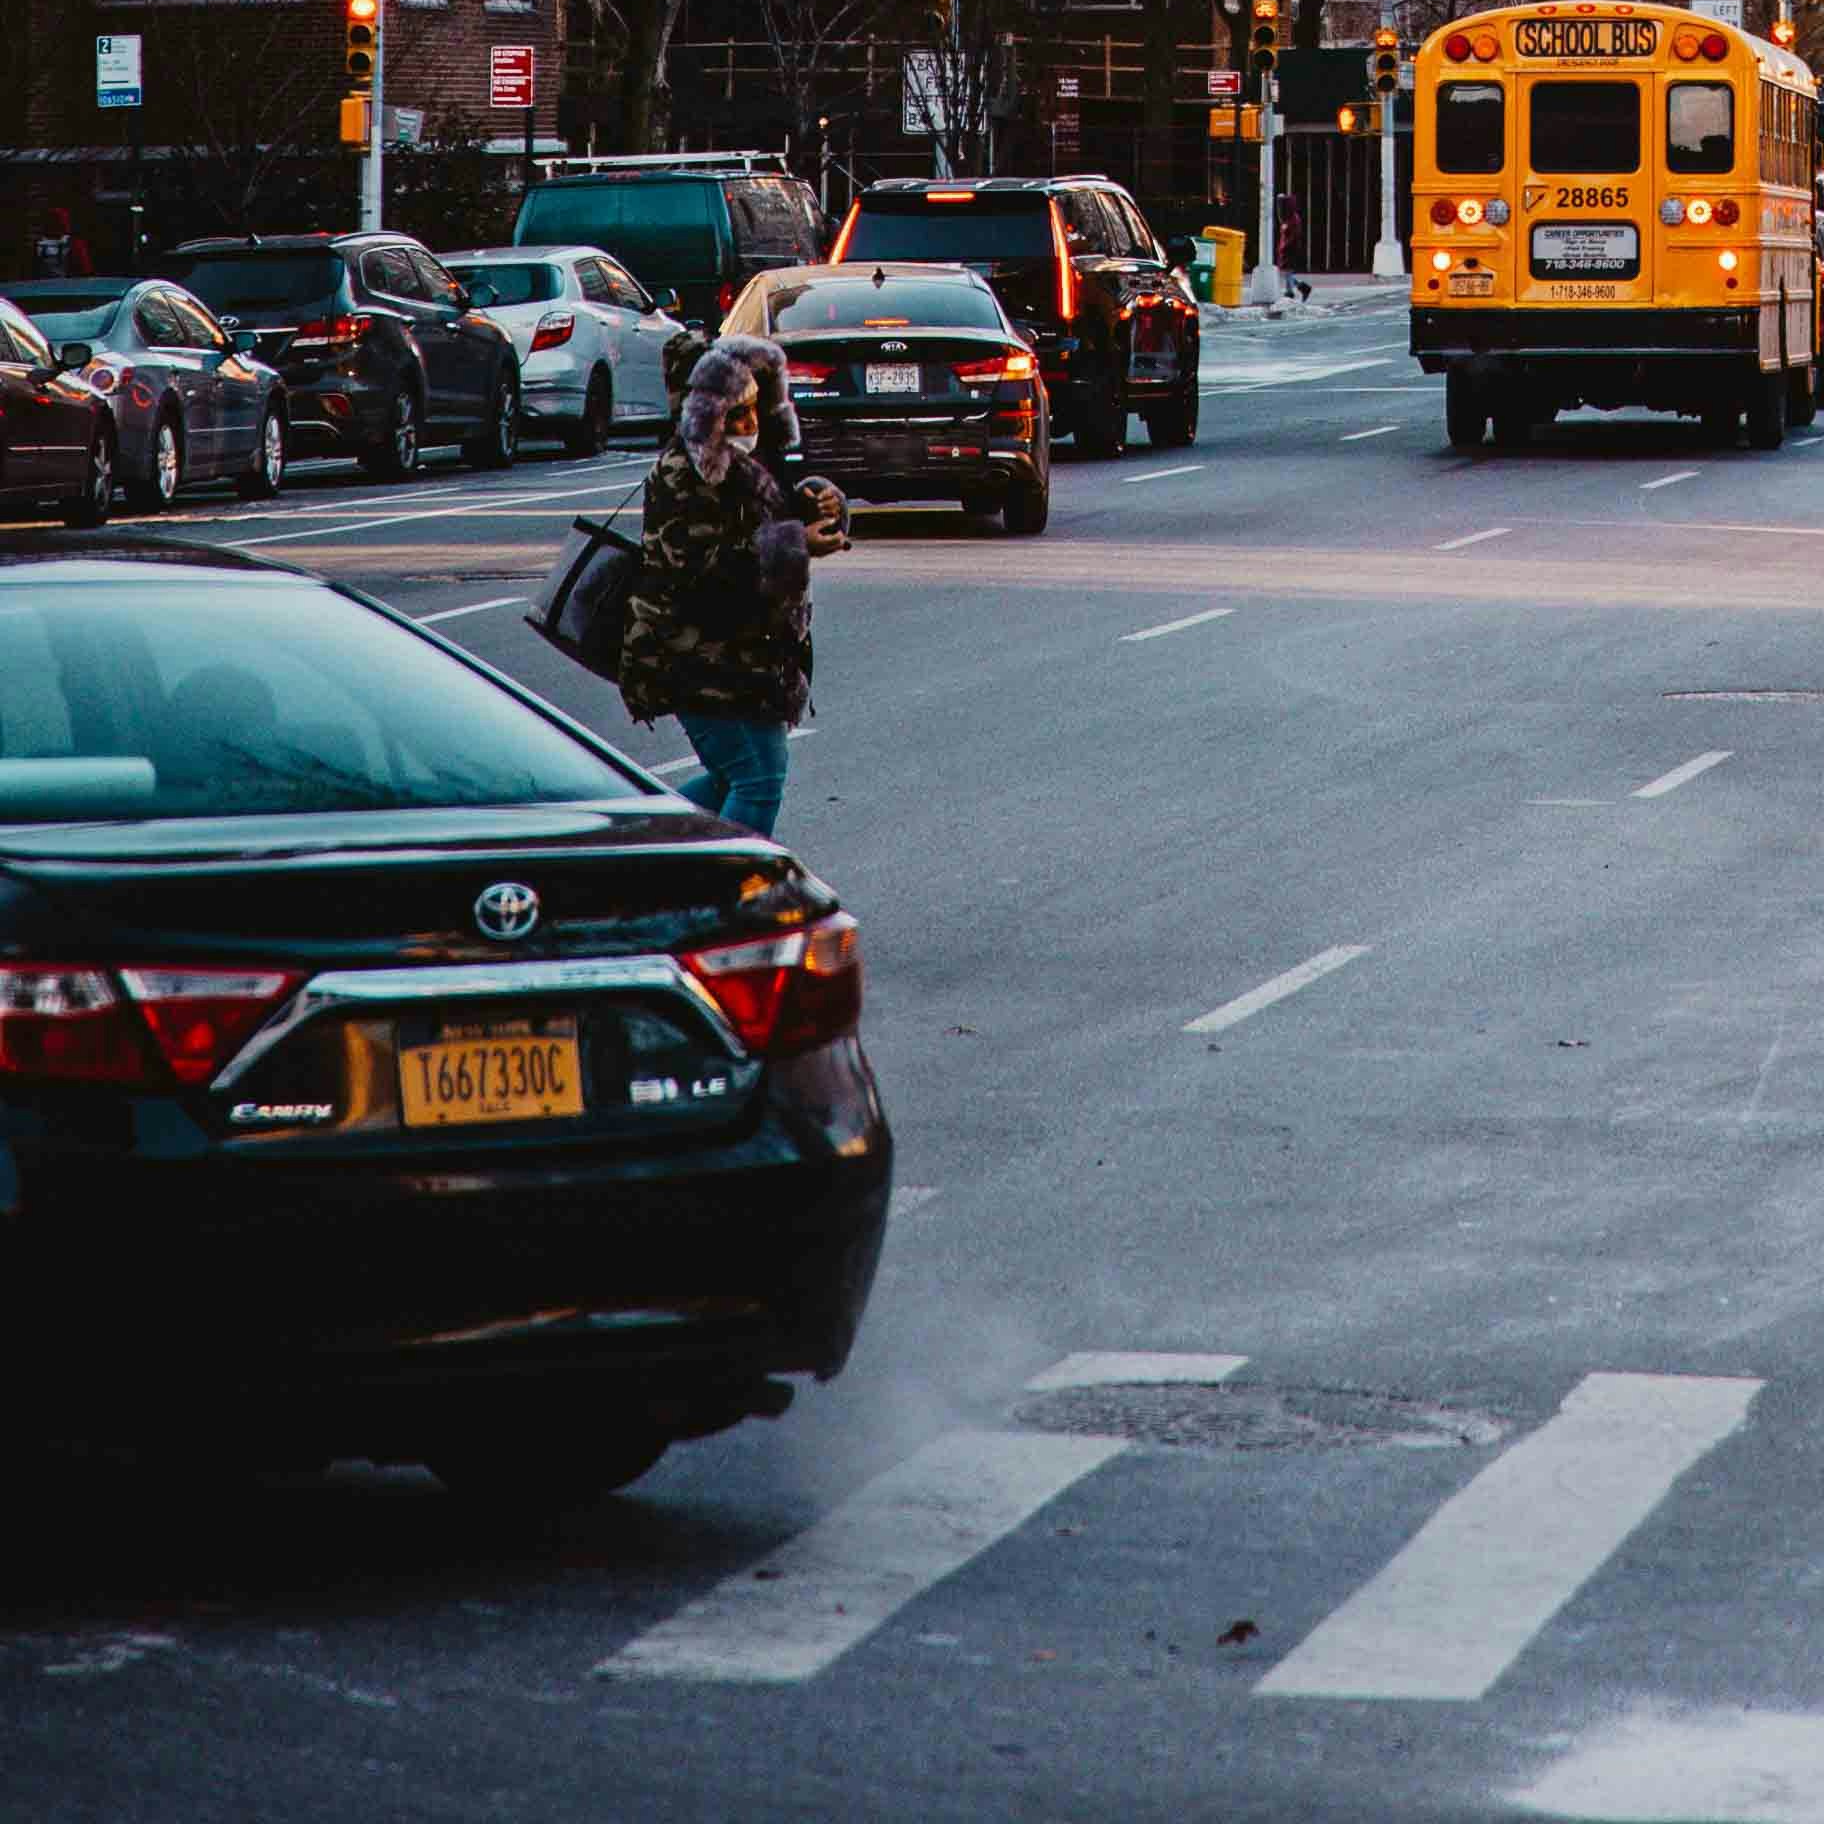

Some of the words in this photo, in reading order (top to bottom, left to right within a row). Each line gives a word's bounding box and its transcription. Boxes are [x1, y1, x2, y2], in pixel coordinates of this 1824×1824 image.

[1522, 25, 1606, 54] SCHOOL
[1611, 25, 1654, 54] BUS
[1556, 187, 1629, 209] 28865
[418, 1043, 566, 1104] T667330C
[693, 1077, 727, 1096] LE
[230, 1103, 332, 1121] CAMRY
